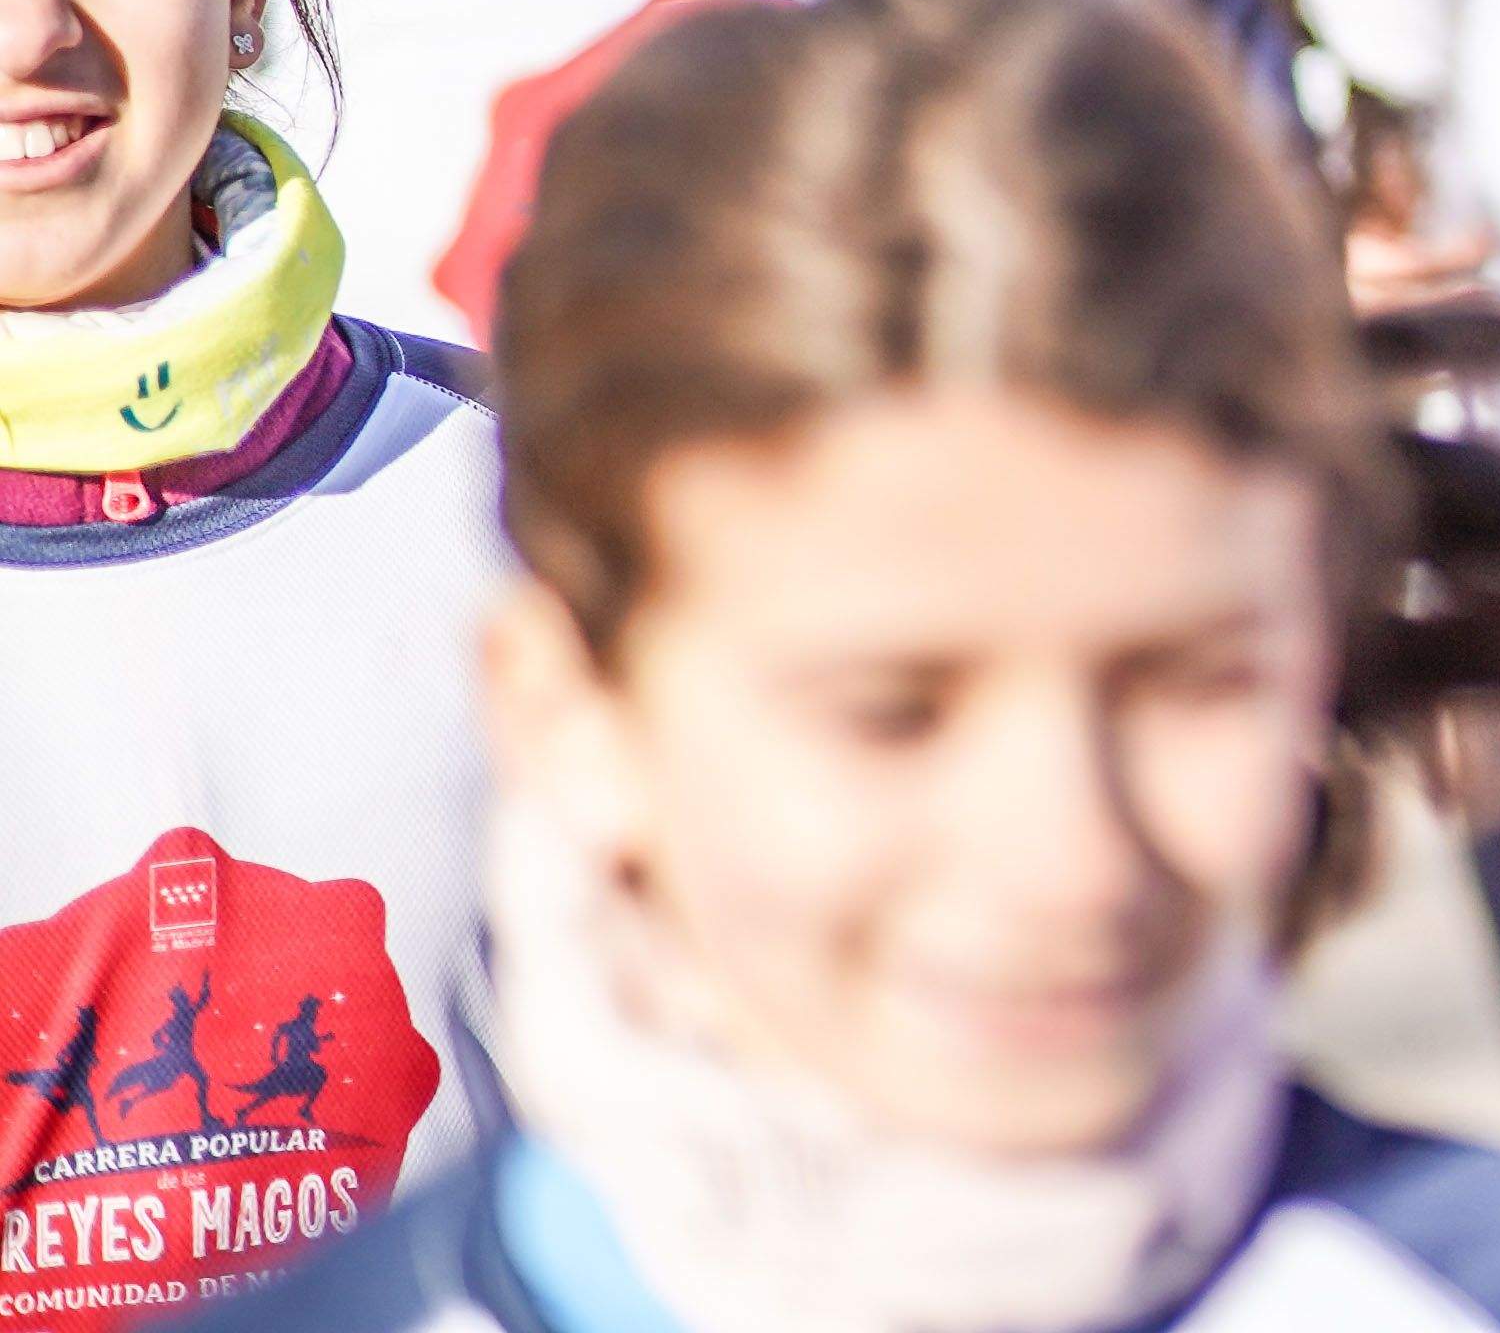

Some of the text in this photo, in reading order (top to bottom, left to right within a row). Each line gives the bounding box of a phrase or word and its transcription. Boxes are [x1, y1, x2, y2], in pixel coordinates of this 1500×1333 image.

[34, 1129, 326, 1183] CARRERA POPULAR
[157, 1170, 206, 1190] de los
[1, 1167, 358, 1273] REYES MAGOS
[0, 1281, 187, 1316] COMUNIDAD
[199, 1275, 237, 1299] DE
